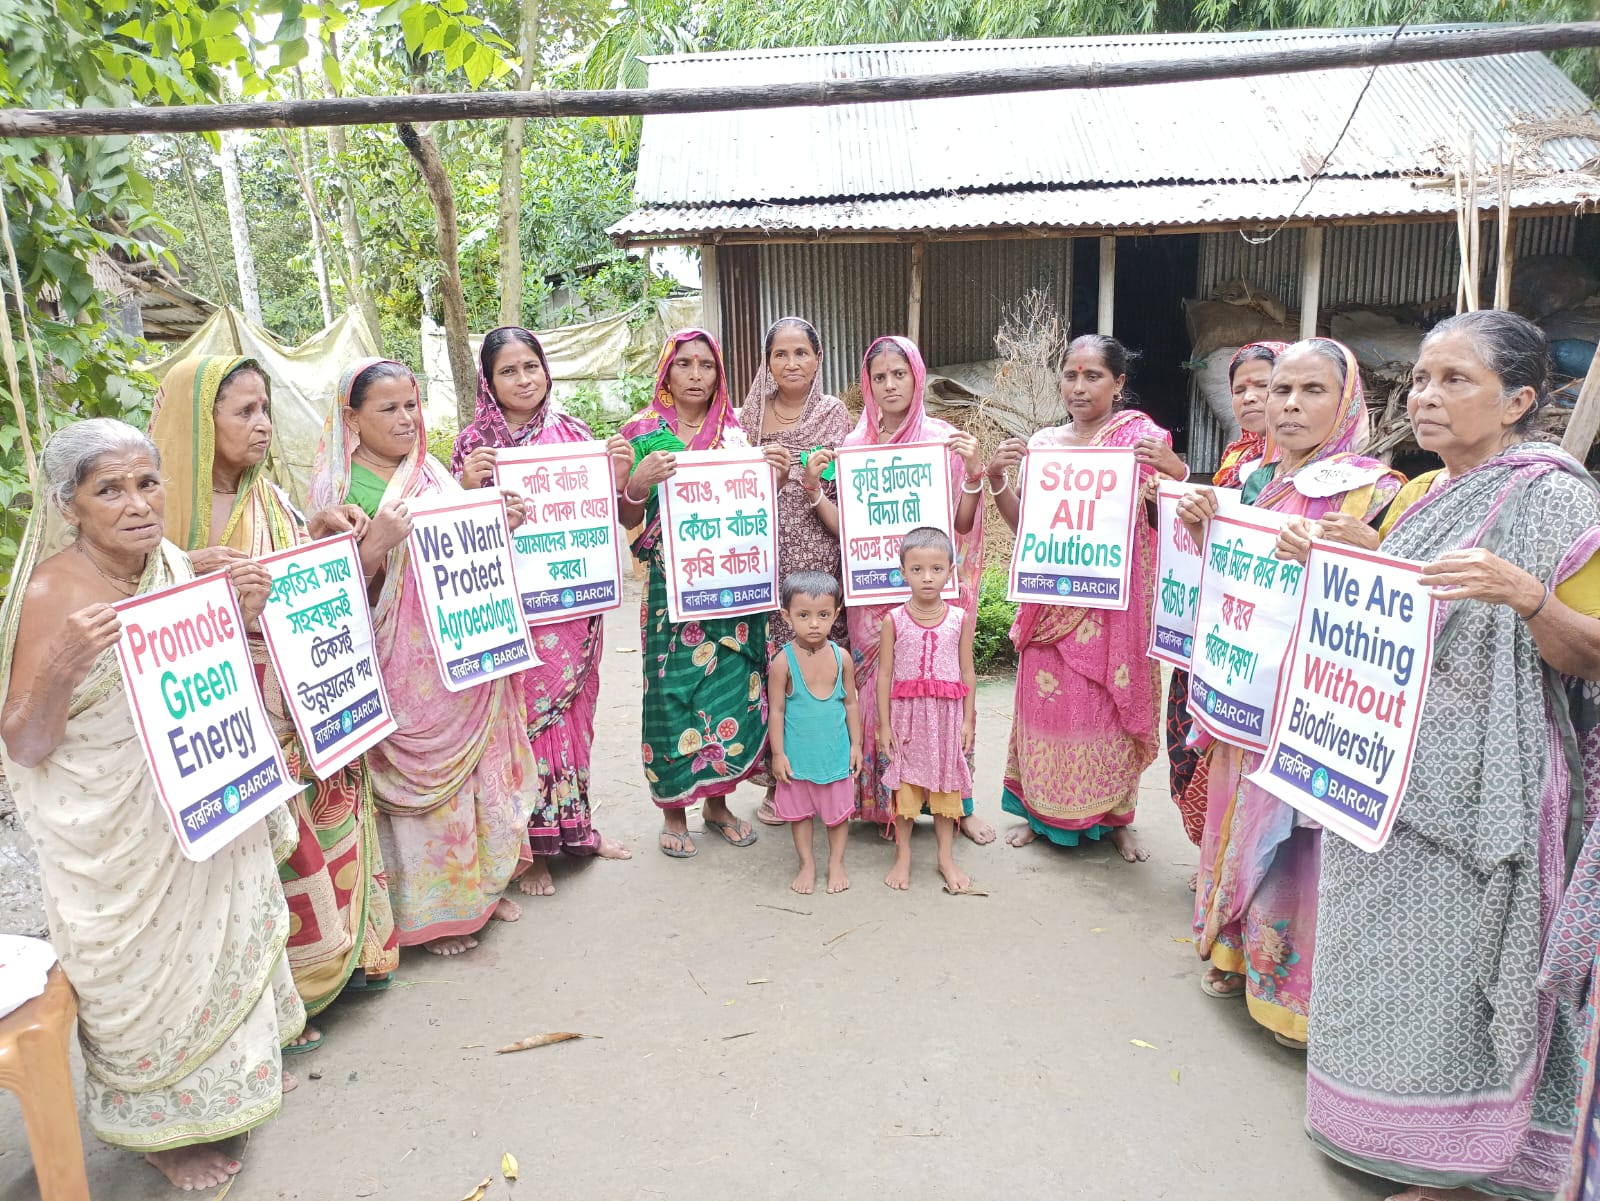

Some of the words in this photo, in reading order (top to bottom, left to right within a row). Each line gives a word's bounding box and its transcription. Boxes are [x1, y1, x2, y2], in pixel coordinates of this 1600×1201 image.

[522, 466, 550, 495] পাখি
[553, 464, 589, 492] বাঁচাই
[674, 480, 720, 504] ব্যাঙ,
[724, 469, 766, 501] পাখি,
[851, 458, 879, 503] কৃষি
[882, 456, 932, 493] প্রতিবেশ
[1040, 461, 1117, 499] Stop
[542, 500, 576, 523] পোকা
[581, 497, 609, 519] খেয়ে
[679, 512, 721, 541] কেঁচো
[726, 508, 768, 537] বাঁচাই
[867, 492, 899, 526] বিদ্যা
[902, 491, 921, 522] মৌ
[1050, 499, 1096, 531] All
[415, 525, 454, 563] We
[454, 516, 504, 555] Want
[514, 531, 566, 555] আমাদের
[569, 526, 609, 550] সহায়তা
[849, 536, 881, 561] পতঙ্গ
[1021, 533, 1121, 568] Polutions
[319, 556, 351, 584] সাথে
[433, 554, 505, 600] Protect
[681, 547, 715, 587] কৃষি
[855, 570, 887, 586] বারসিক
[1021, 575, 1055, 590] বারসিক
[1072, 581, 1118, 595] BARCIK
[1209, 539, 1232, 578] সবাই
[1228, 538, 1254, 582] মিলে
[1253, 548, 1279, 590] করি
[1279, 562, 1303, 597] পণ
[524, 592, 559, 609] বারসিক
[576, 585, 613, 602] BARCIK
[684, 591, 718, 607] বারসিক
[734, 586, 770, 602] BARCIK
[1323, 562, 1360, 608] We
[1365, 575, 1414, 623] Are
[437, 592, 519, 651] Agroecology
[1233, 598, 1256, 632] হবে
[126, 600, 235, 675] Promote
[311, 624, 354, 668] টেকসই
[1205, 624, 1229, 670] পরিবেশ
[1309, 608, 1415, 687] Nothing
[450, 658, 480, 680] বারসিক
[493, 643, 528, 667] BARCIK
[160, 660, 238, 720] Green
[297, 666, 356, 715] উন্নয়নের
[356, 656, 373, 682] পথ
[1303, 653, 1406, 729] Without
[314, 718, 341, 744] বারসিক
[352, 696, 380, 724] BARCIK
[1214, 697, 1261, 729] BARCIK
[167, 706, 257, 778] Energy
[1288, 697, 1395, 785] Biodiversity
[184, 796, 222, 832] বারসিক
[239, 762, 279, 800] BARCIK
[1278, 750, 1312, 783] বারসিক
[1327, 777, 1383, 822] BARCIK
